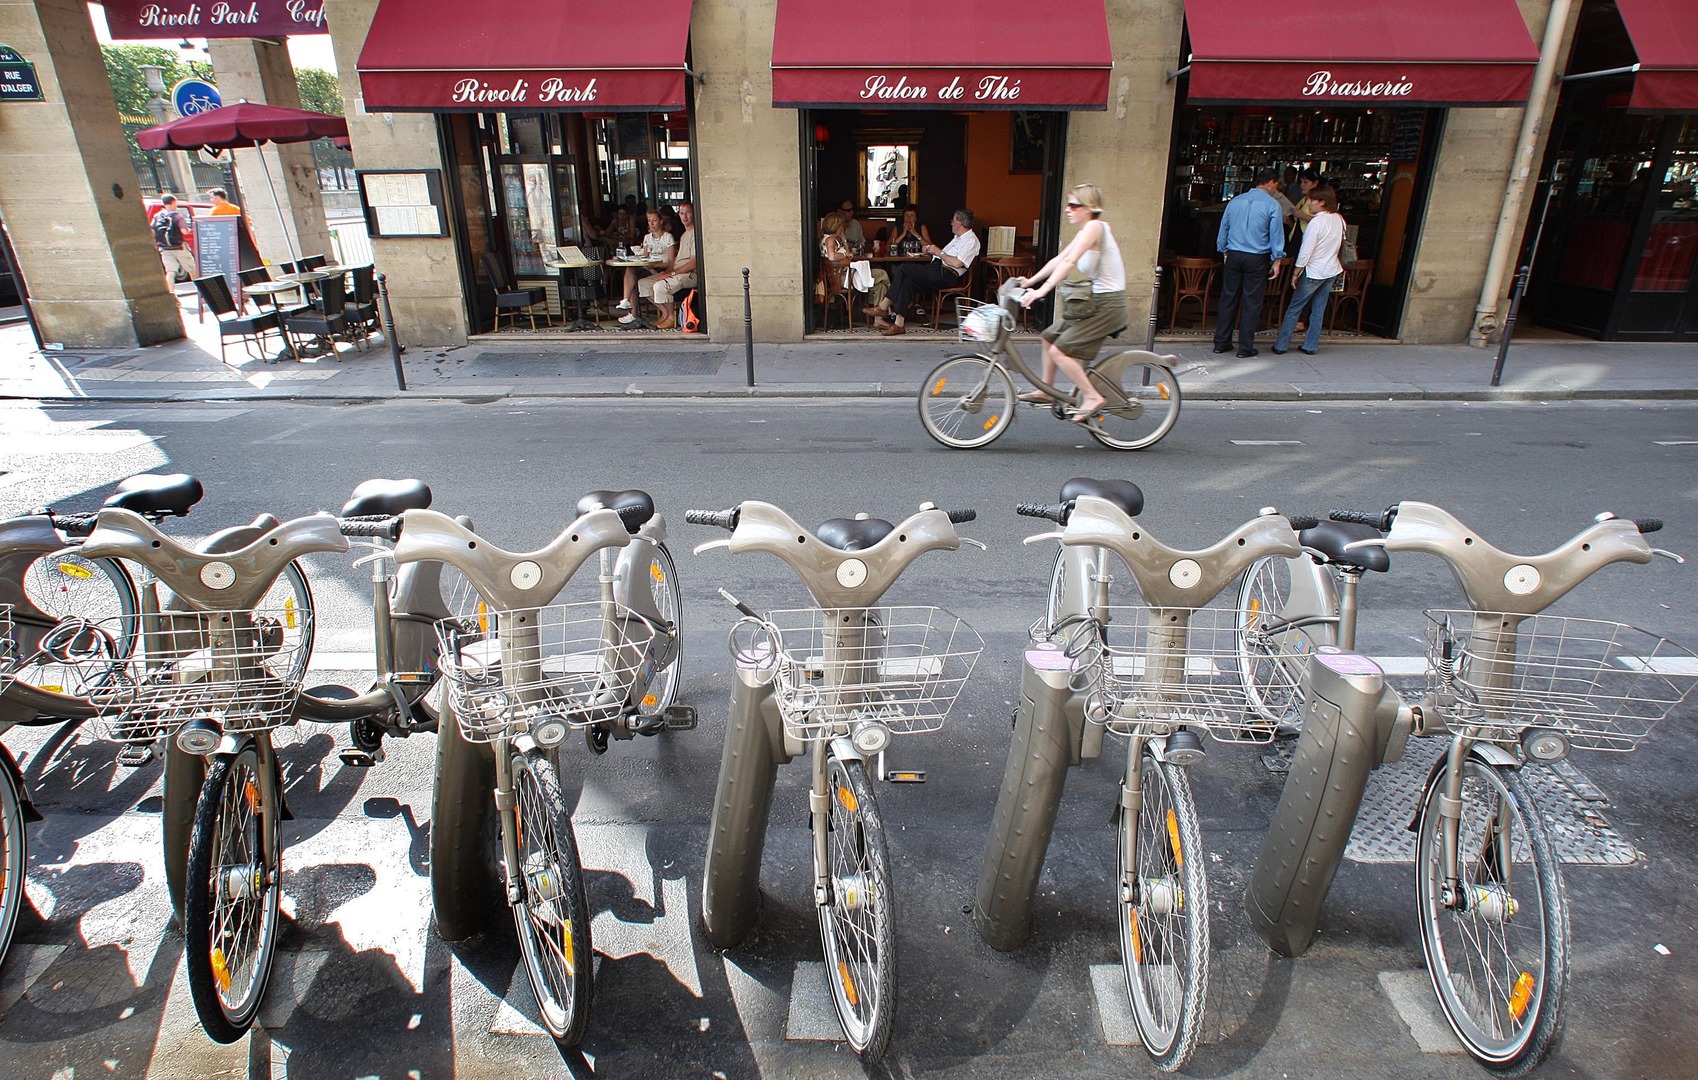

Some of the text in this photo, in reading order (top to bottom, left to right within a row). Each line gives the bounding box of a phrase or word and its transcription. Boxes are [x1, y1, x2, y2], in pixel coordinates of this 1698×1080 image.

[139, 4, 201, 27] Rivoli
[210, 2, 259, 25] Park
[4, 71, 22, 80] RUE
[859, 75, 1022, 100] Salon de Thé
[1302, 70, 1413, 96] Brasserie
[452, 77, 598, 103] Rivoli Park
